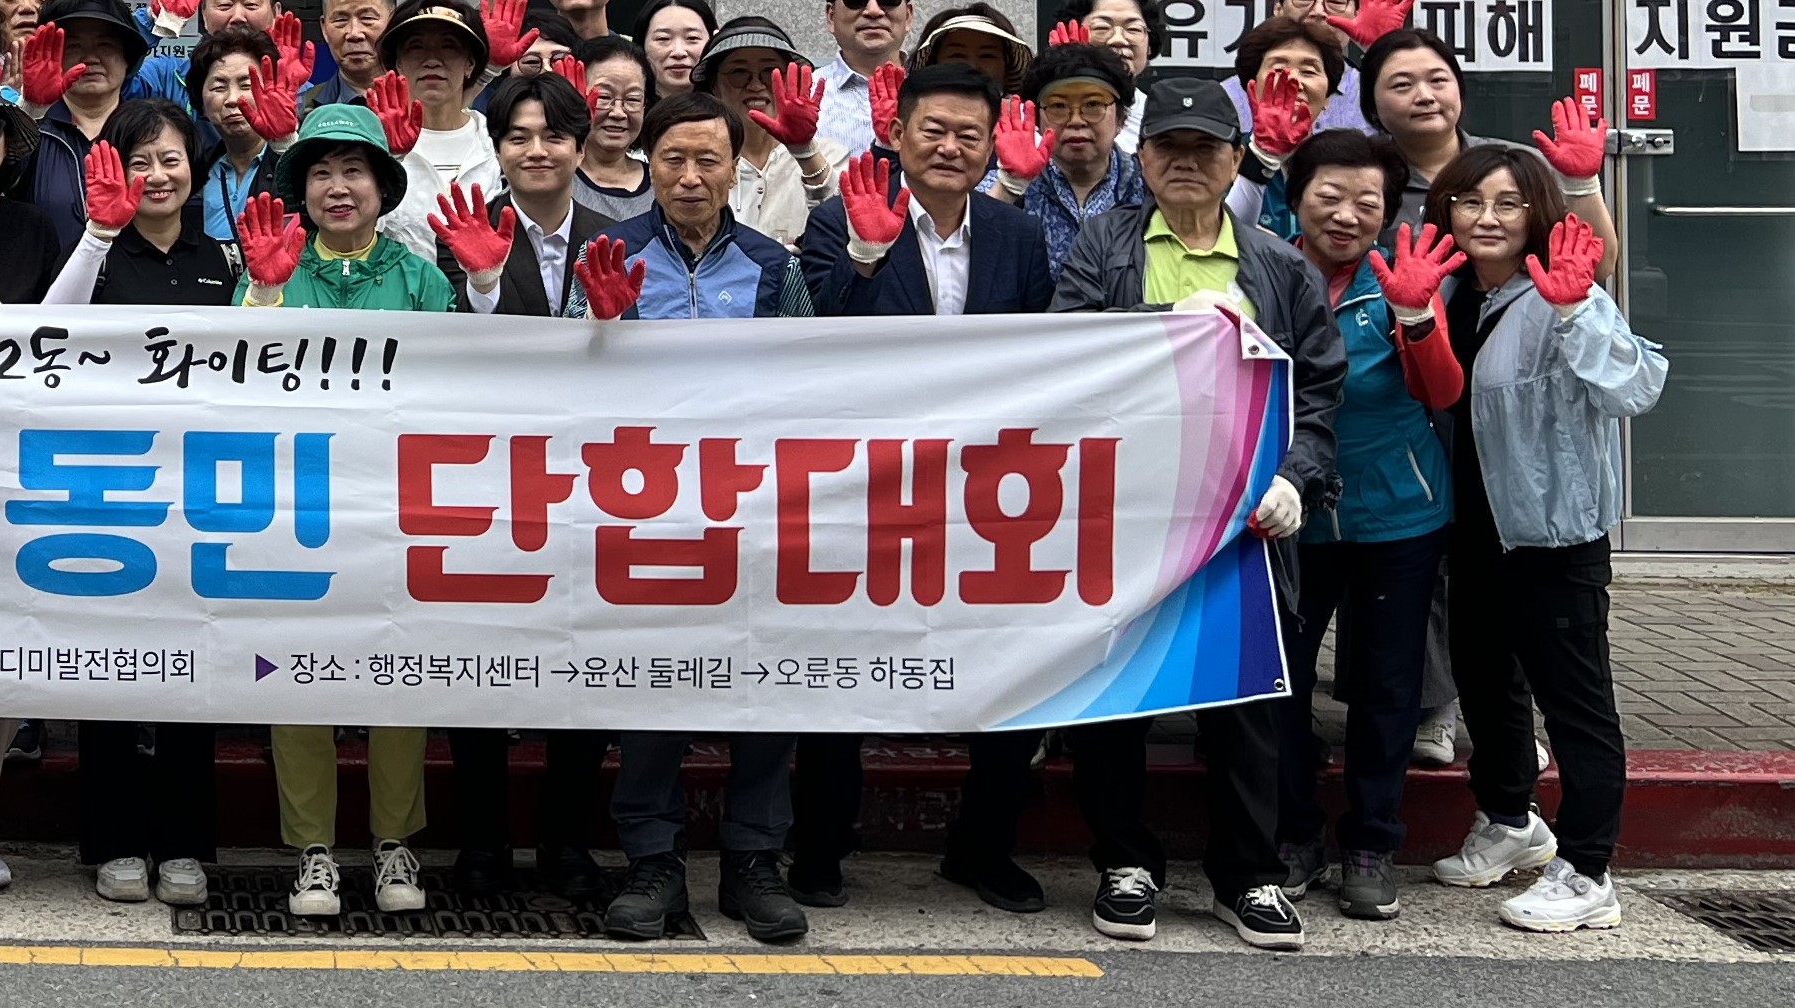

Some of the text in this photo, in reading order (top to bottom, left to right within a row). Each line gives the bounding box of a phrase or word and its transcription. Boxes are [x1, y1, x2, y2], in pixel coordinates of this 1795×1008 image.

[1420, 0, 1544, 63] 피해
[1632, 72, 1652, 116] 폐문
[137, 325, 400, 393] 화이팅!!!
[5, 428, 338, 601] 동민
[397, 426, 1123, 606] 단합대회
[290, 652, 347, 685] 장소
[368, 653, 540, 688] 행정복지센터
[647, 656, 732, 689] 둘레길
[869, 656, 955, 690] 하동집
